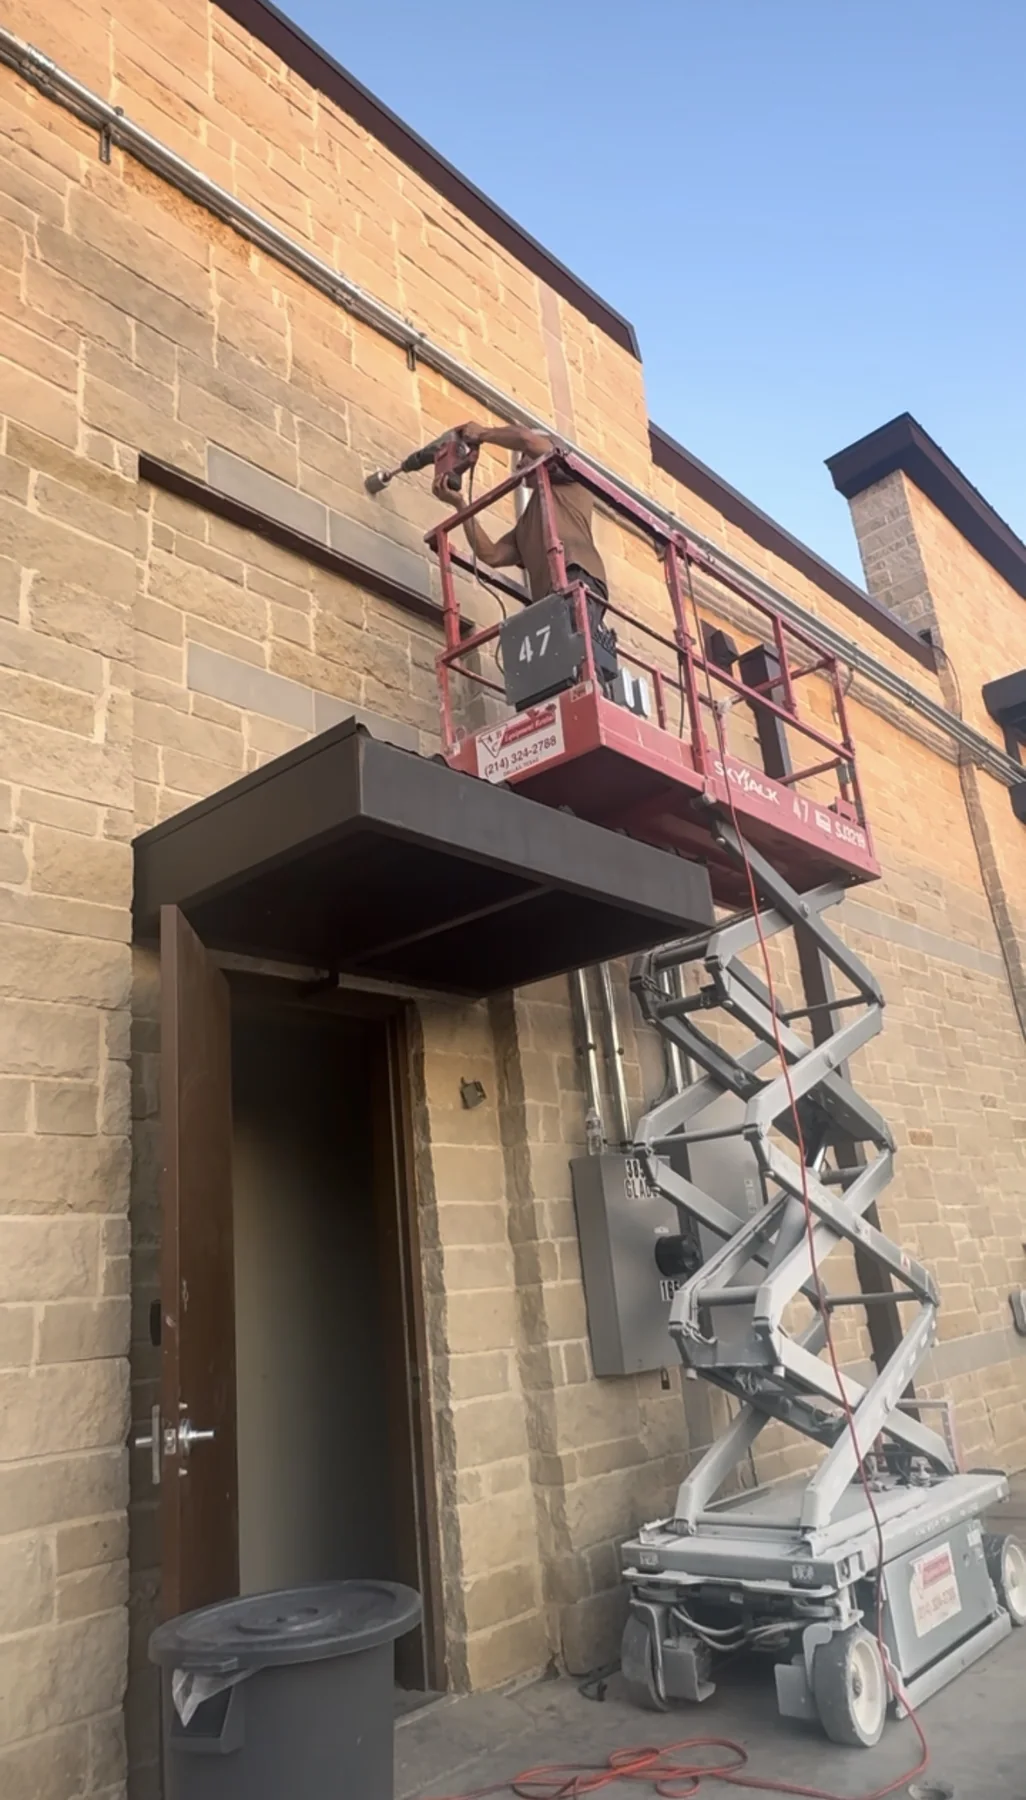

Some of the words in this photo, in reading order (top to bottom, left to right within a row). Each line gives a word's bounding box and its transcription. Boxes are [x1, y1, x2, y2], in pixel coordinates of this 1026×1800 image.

[519, 625, 551, 663] 47
[484, 756, 510, 777] (214)
[511, 735, 557, 764] 324-2788
[713, 760, 781, 805] SKYJACK
[793, 796, 809, 823] 47
